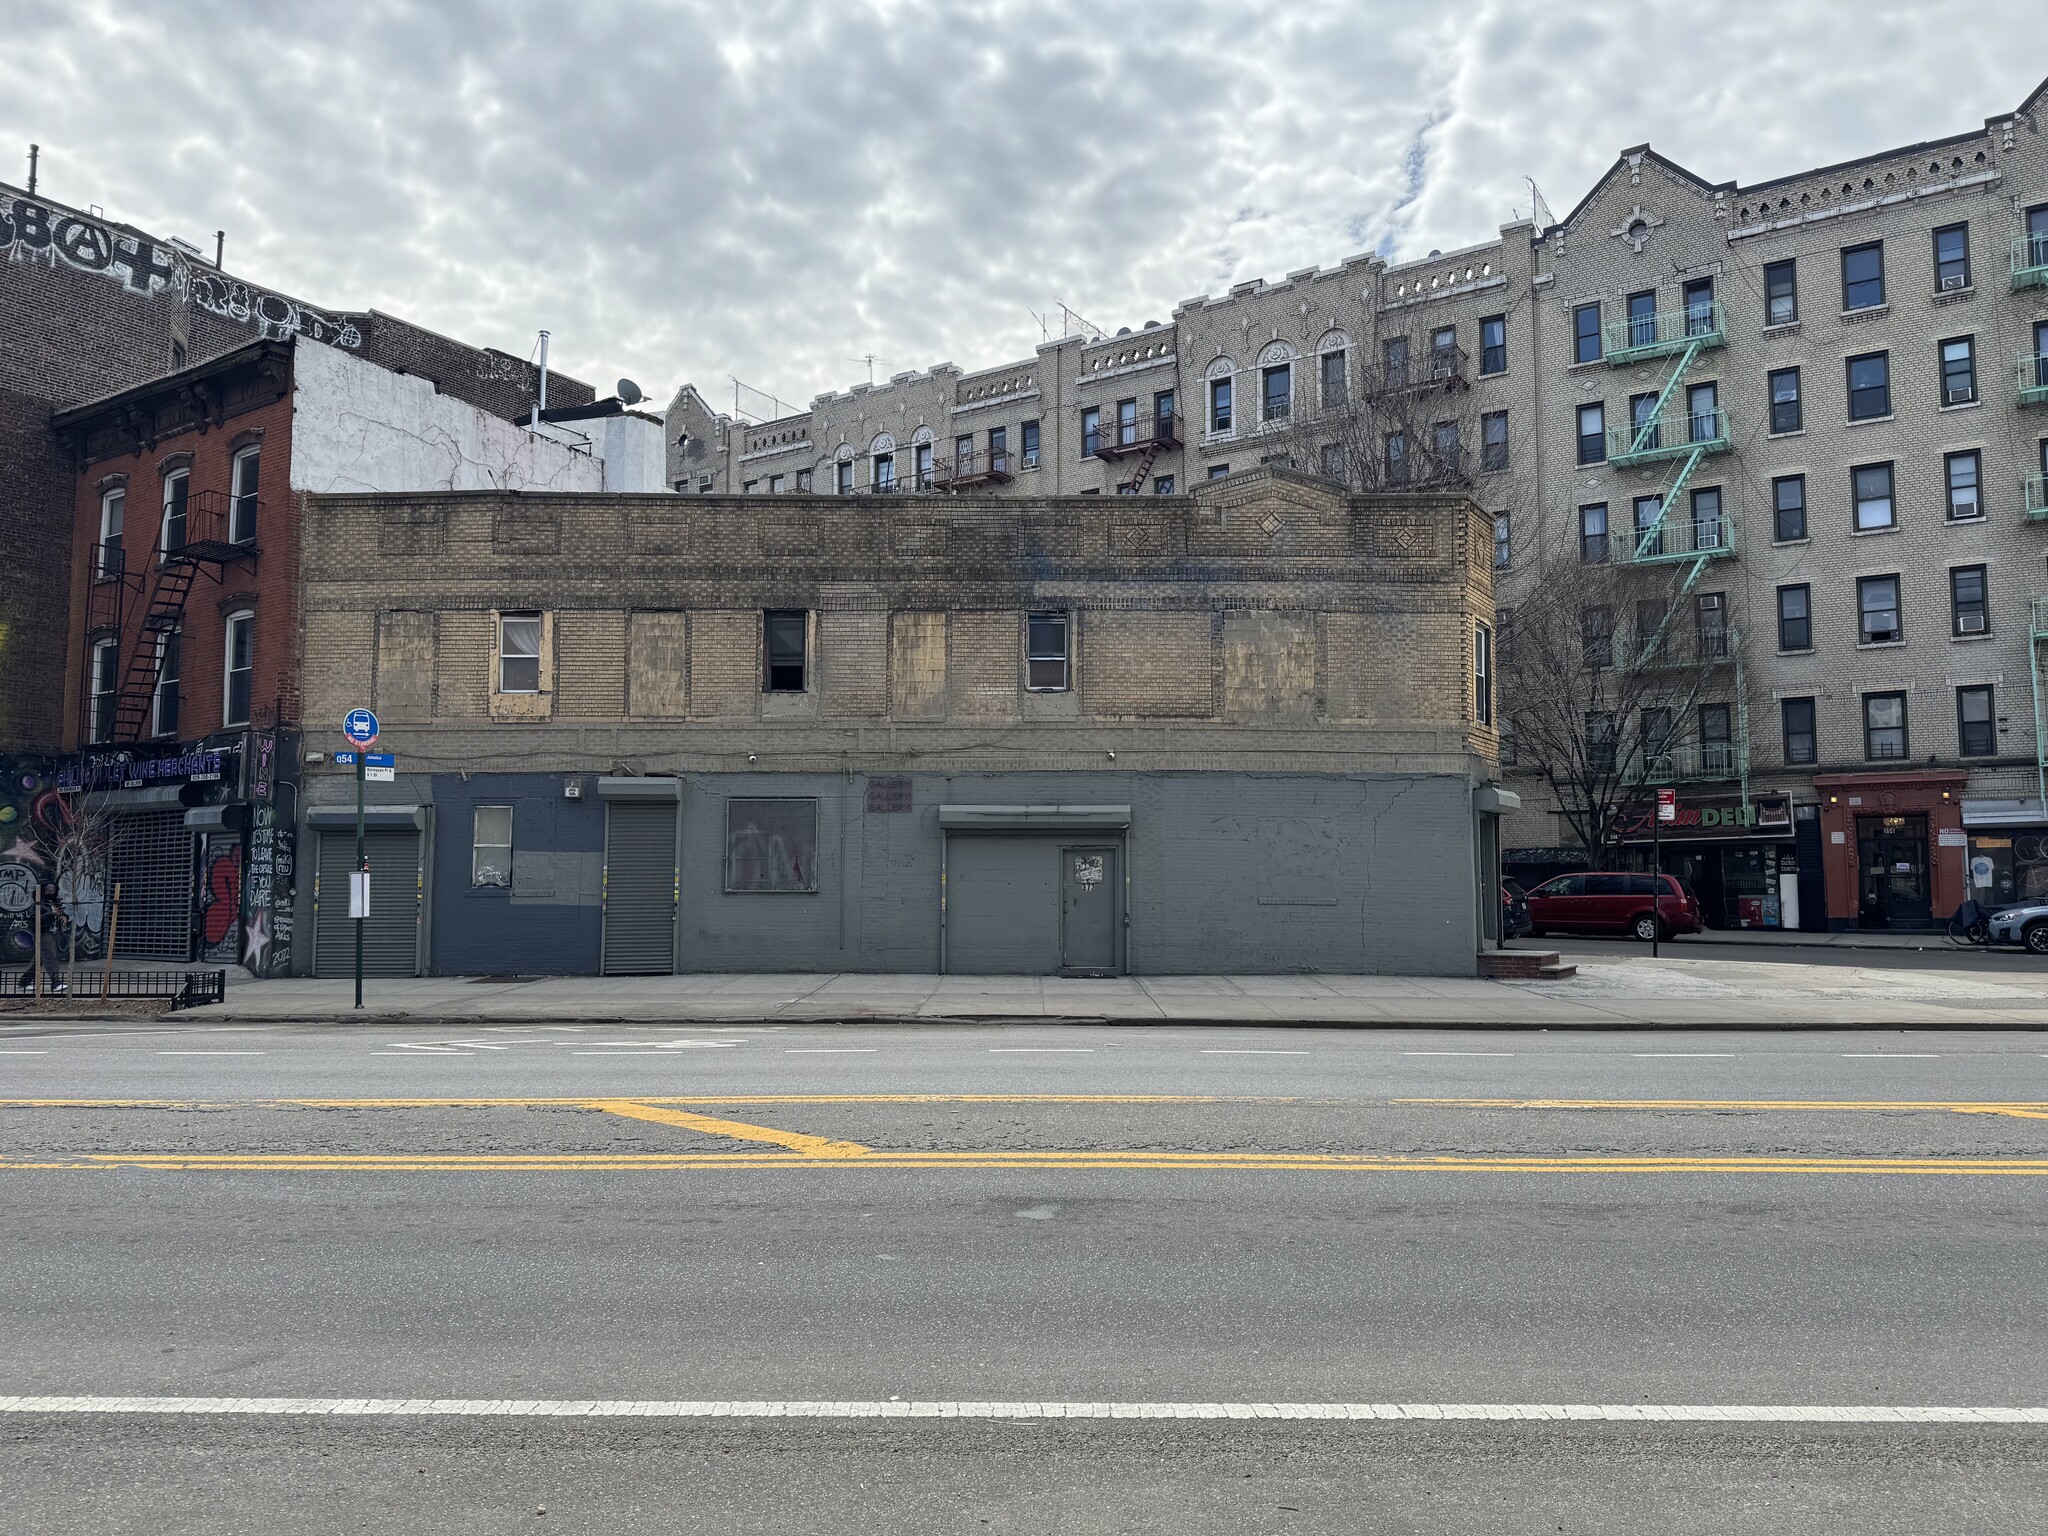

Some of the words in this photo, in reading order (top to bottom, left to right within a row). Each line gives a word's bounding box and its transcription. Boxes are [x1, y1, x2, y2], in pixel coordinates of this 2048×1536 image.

[129, 759, 155, 780] WINE
[157, 752, 221, 778] MERCHANTS
[257, 739, 273, 796] WINE
[336, 754, 353, 763] Q54
[252, 805, 273, 828] NOW
[1702, 805, 1757, 828] DELI
[258, 875, 271, 889] YOU
[250, 890, 271, 907] DARE
[272, 947, 291, 966] 2022
